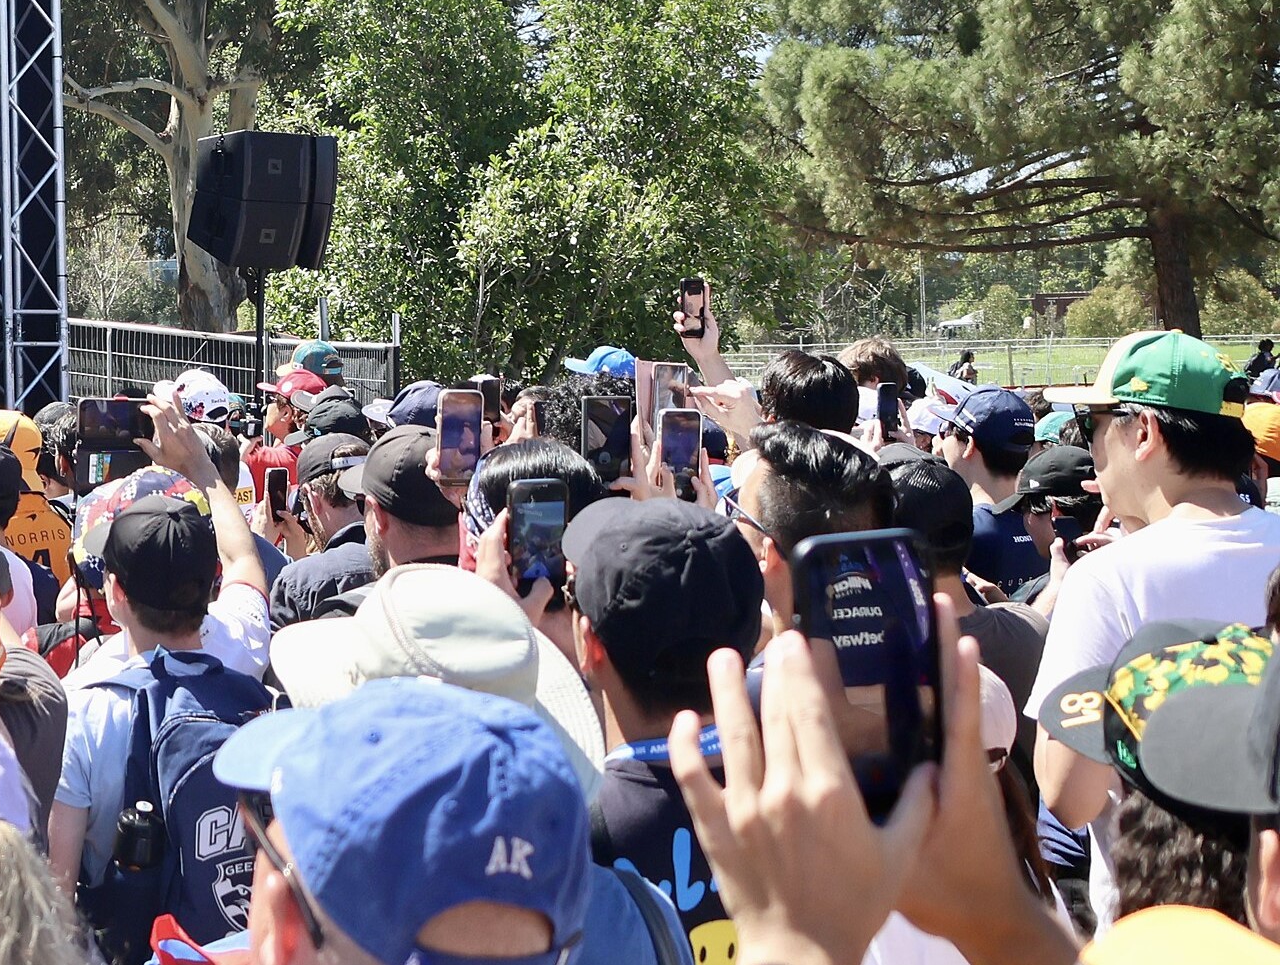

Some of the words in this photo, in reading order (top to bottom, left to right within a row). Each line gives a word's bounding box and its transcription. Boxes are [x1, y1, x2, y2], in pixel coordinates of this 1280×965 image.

[234, 490, 253, 503] AST
[4, 529, 66, 546] NORRIS
[225, 862, 256, 876] GEE
